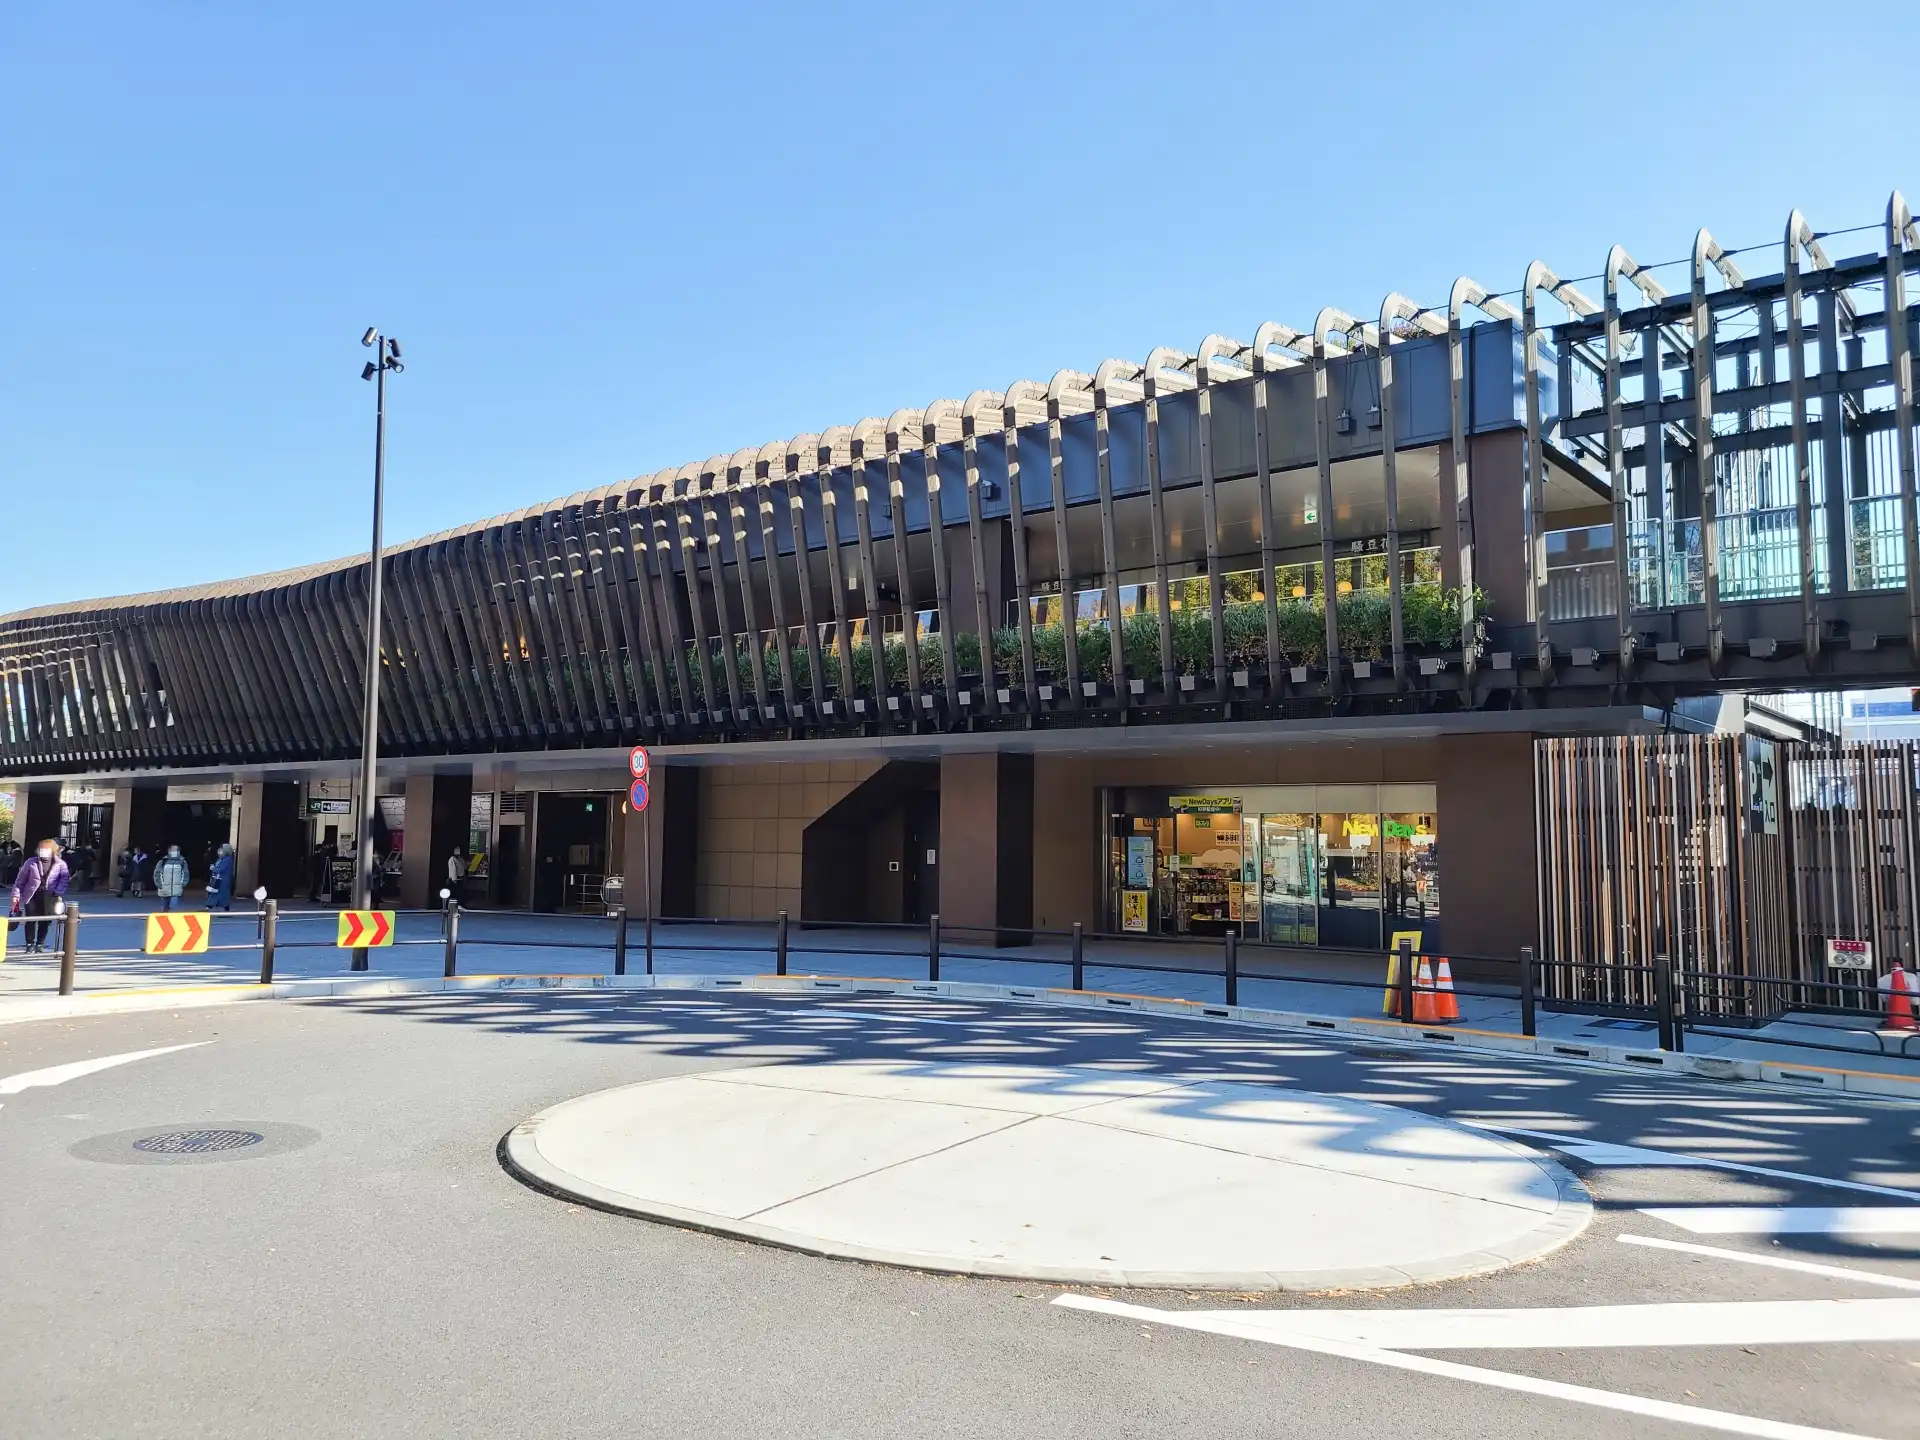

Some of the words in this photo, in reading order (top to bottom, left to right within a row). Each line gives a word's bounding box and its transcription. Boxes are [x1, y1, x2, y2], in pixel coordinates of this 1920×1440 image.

[634, 755, 643, 769] 30
[1749, 760, 1758, 811] P
[1188, 798, 1233, 808] NewDaysアプリ
[1764, 800, 1776, 823] 入口
[1342, 820, 1379, 837] New
[1383, 820, 1427, 839] Days
